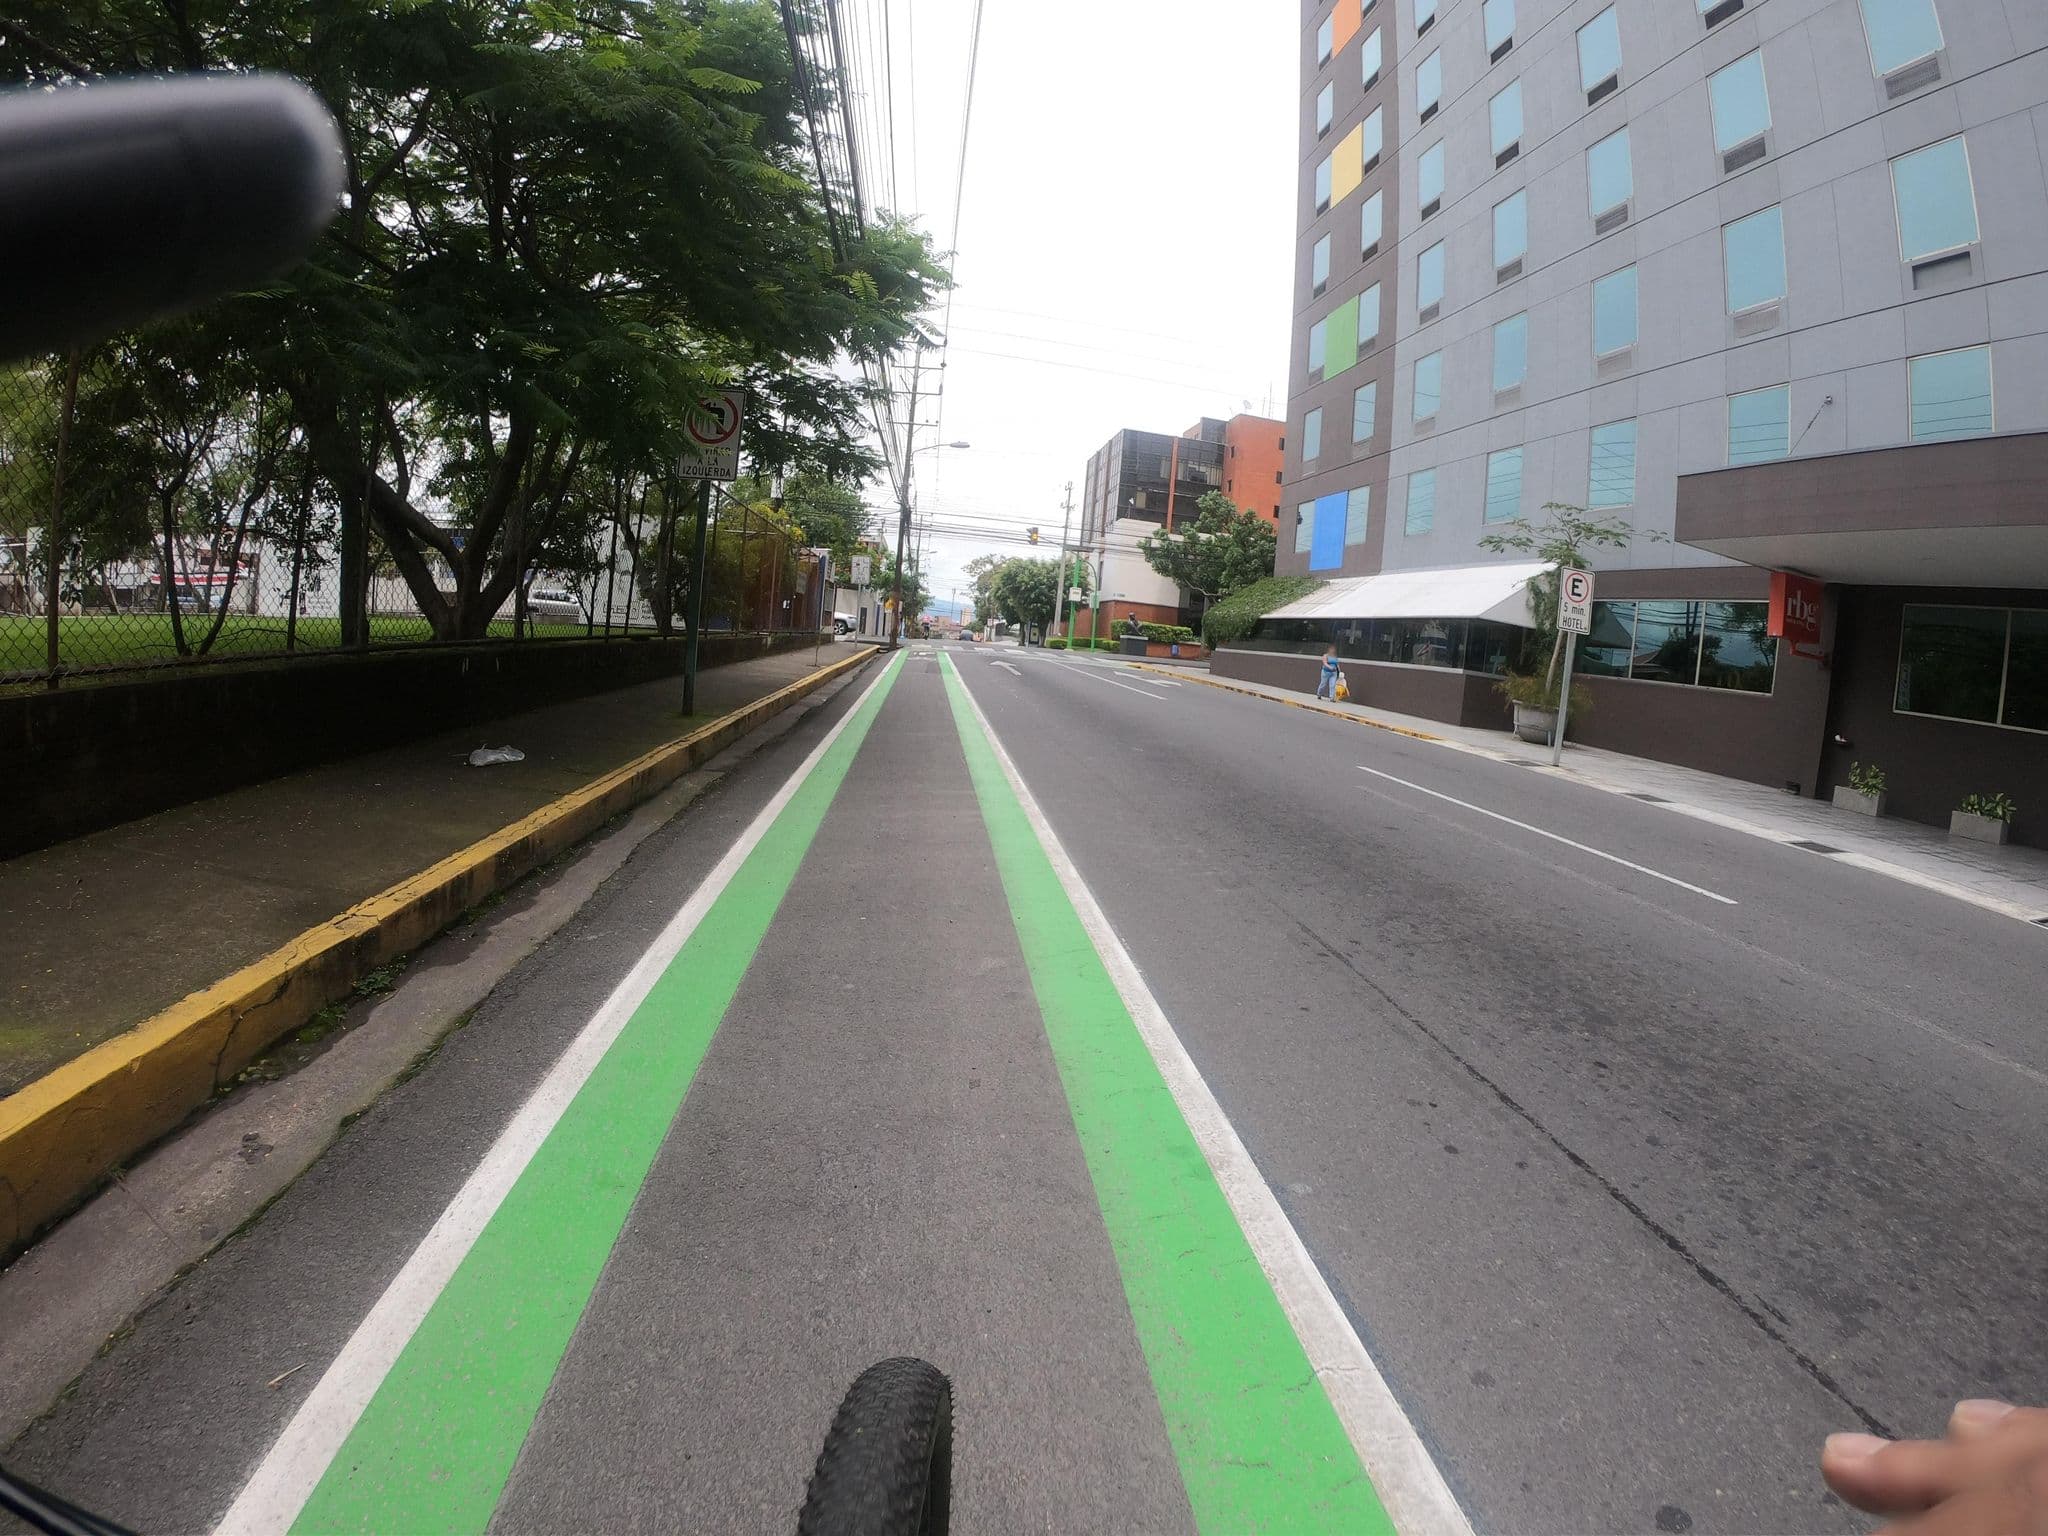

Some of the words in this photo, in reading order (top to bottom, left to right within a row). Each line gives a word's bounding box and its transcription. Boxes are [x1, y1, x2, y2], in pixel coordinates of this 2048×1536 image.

[697, 457, 703, 465] A
[707, 456, 719, 466] LA
[1571, 577, 1583, 597] E
[1563, 602, 1568, 612] 5
[1786, 590, 1819, 632] rbg
[1562, 616, 1583, 629] HOTEL
